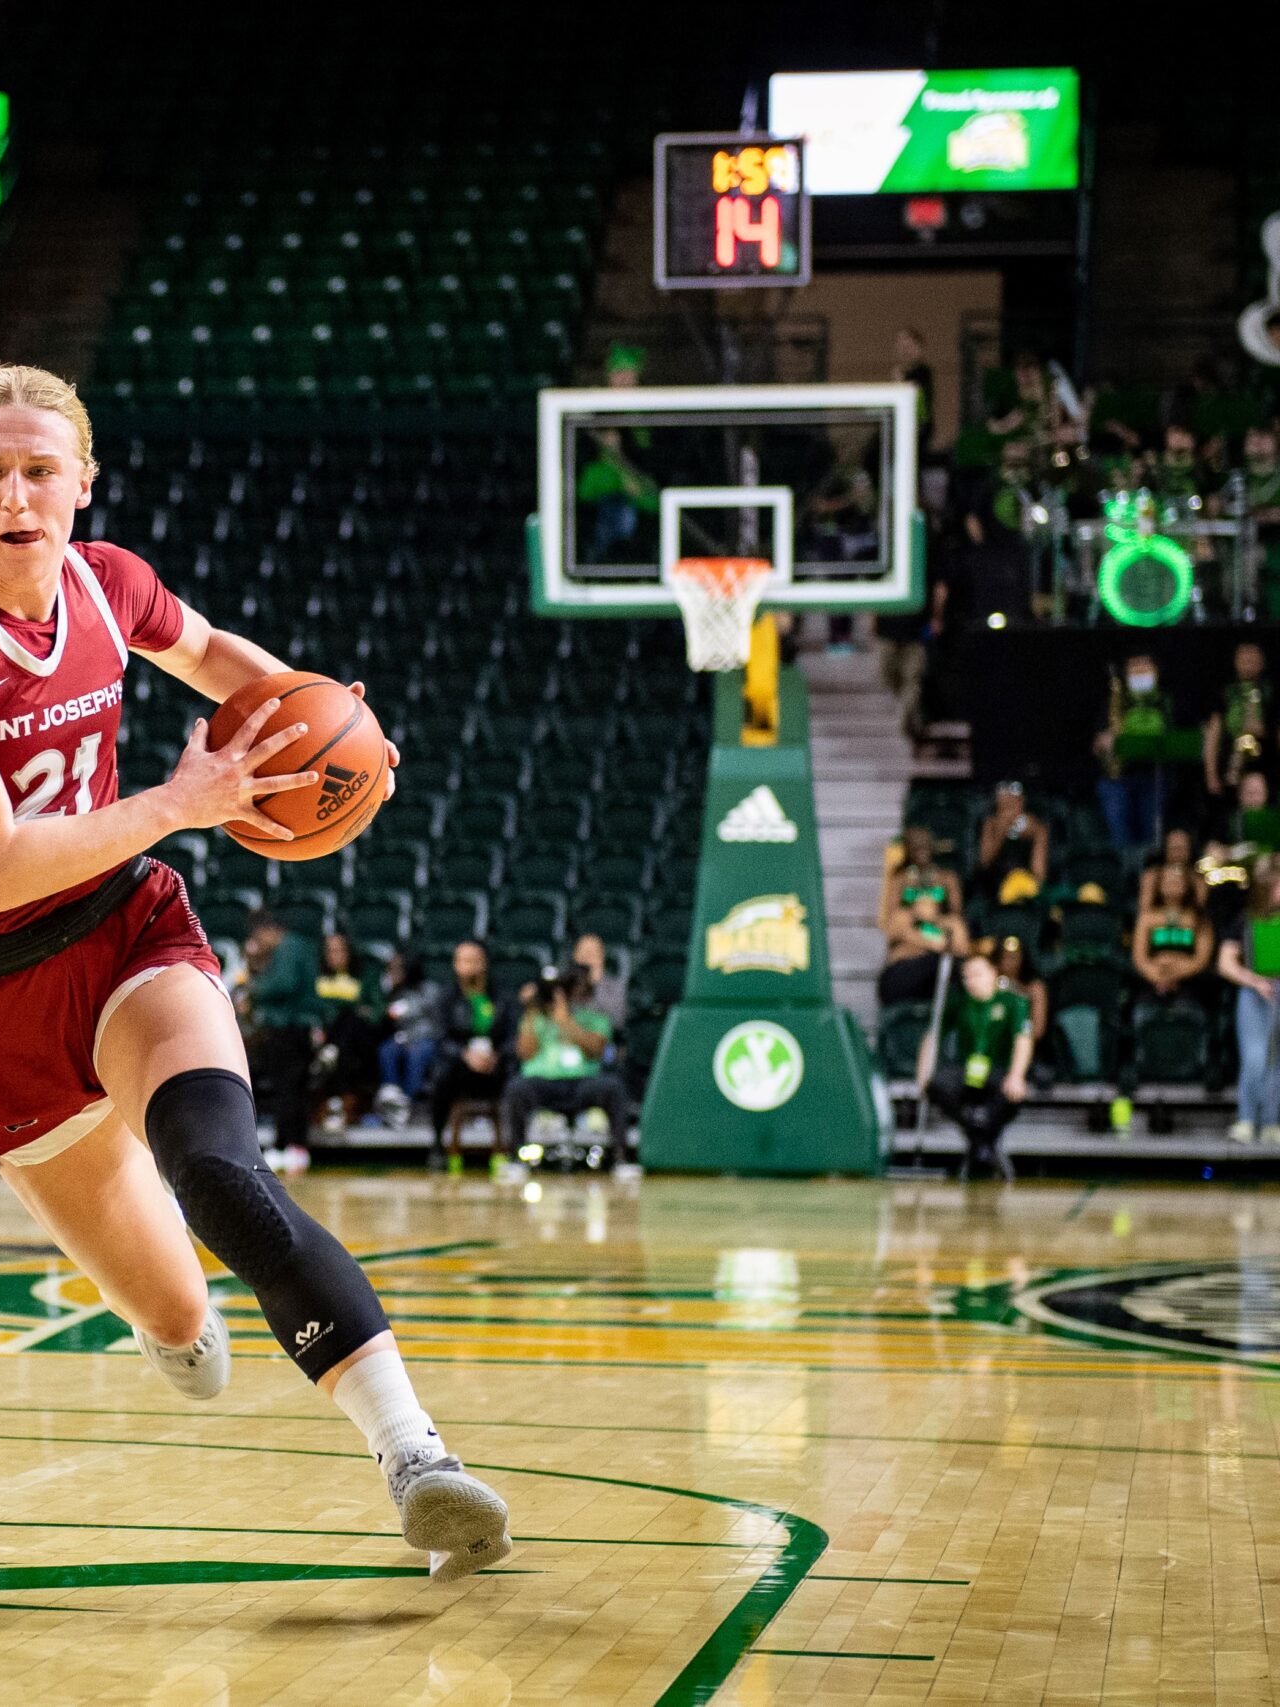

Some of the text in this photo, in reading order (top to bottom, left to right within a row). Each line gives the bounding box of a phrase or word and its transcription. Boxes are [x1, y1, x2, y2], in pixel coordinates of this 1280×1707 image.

[714, 194, 781, 268] 14
[10, 731, 102, 826] 21
[315, 769, 370, 821] adidas
